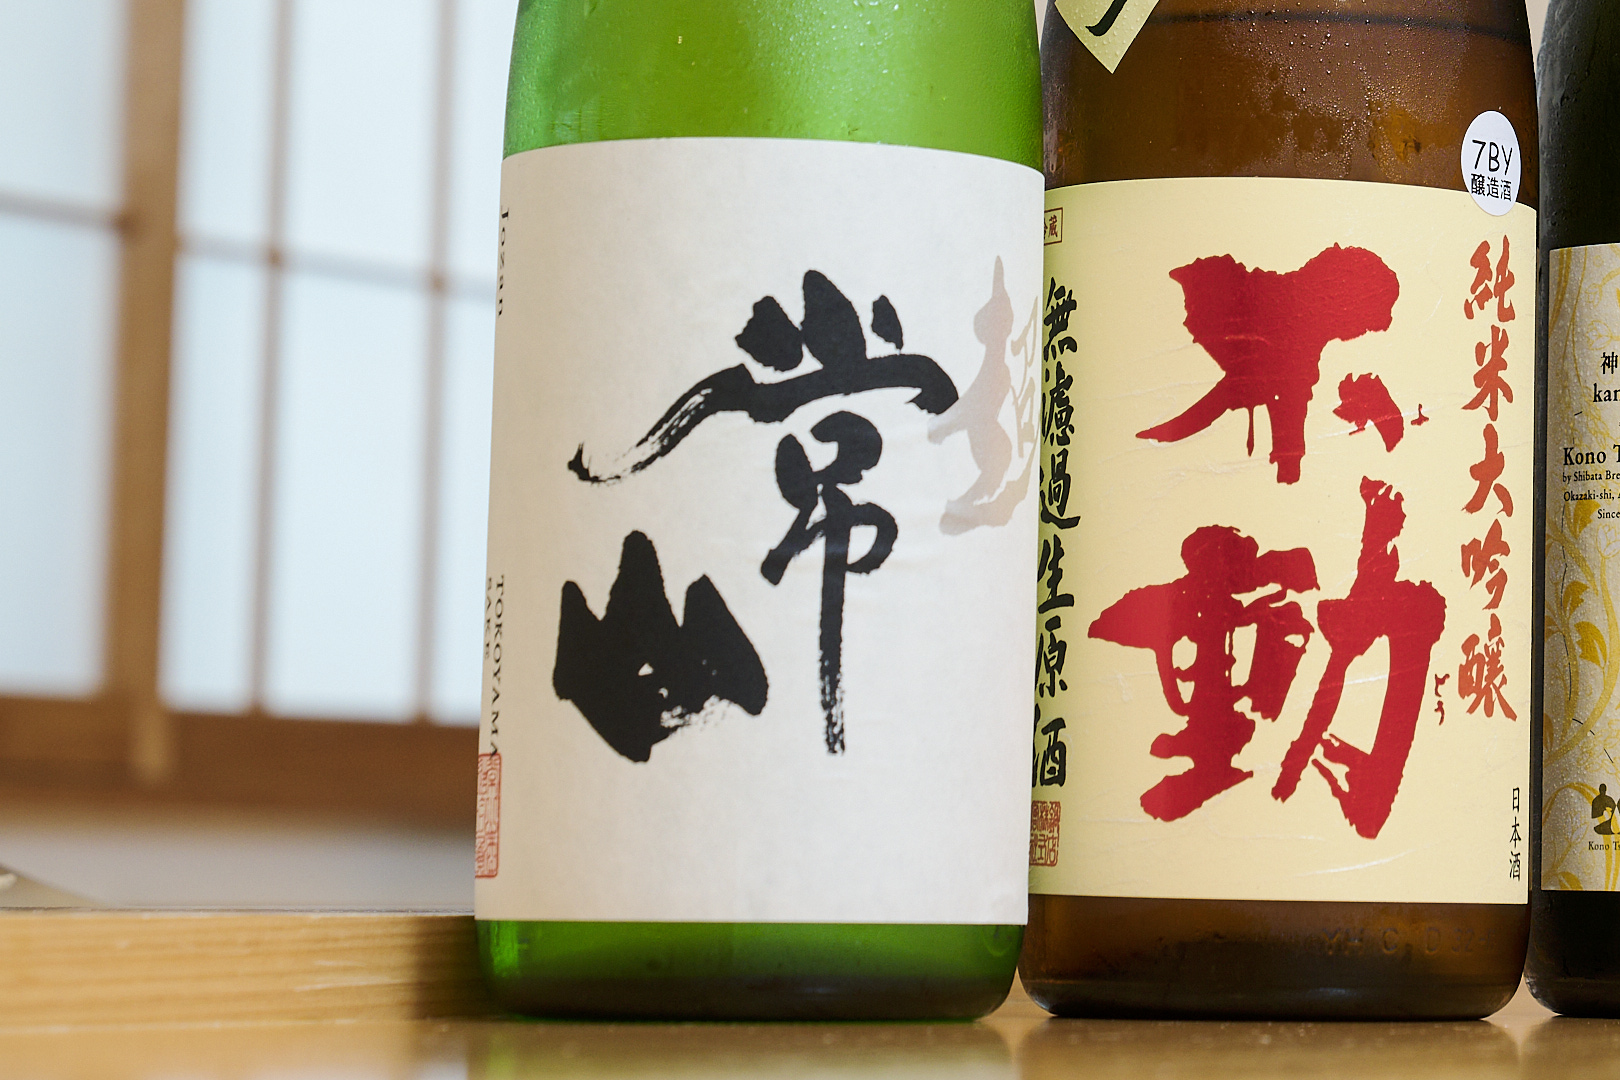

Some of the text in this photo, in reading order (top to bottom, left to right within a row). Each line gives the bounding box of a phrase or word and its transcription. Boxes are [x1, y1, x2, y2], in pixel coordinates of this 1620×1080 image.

[1472, 139, 1513, 176] 7BY
[1470, 173, 1512, 202] 醸造酒
[1563, 447, 1607, 466] Kono
[1458, 235, 1518, 723] 純米大吟醸
[1562, 472, 1571, 483] by
[1573, 470, 1603, 482] Shibata
[1563, 490, 1615, 502] Okazaki-shi,
[1597, 508, 1620, 519] Since
[1031, 277, 1081, 788] 無濾過生原酒
[1089, 242, 1448, 838] 不動
[489, 574, 504, 759] TOKOYAMA
[1509, 787, 1521, 881] 日本酒
[1588, 841, 1610, 851] Kono
